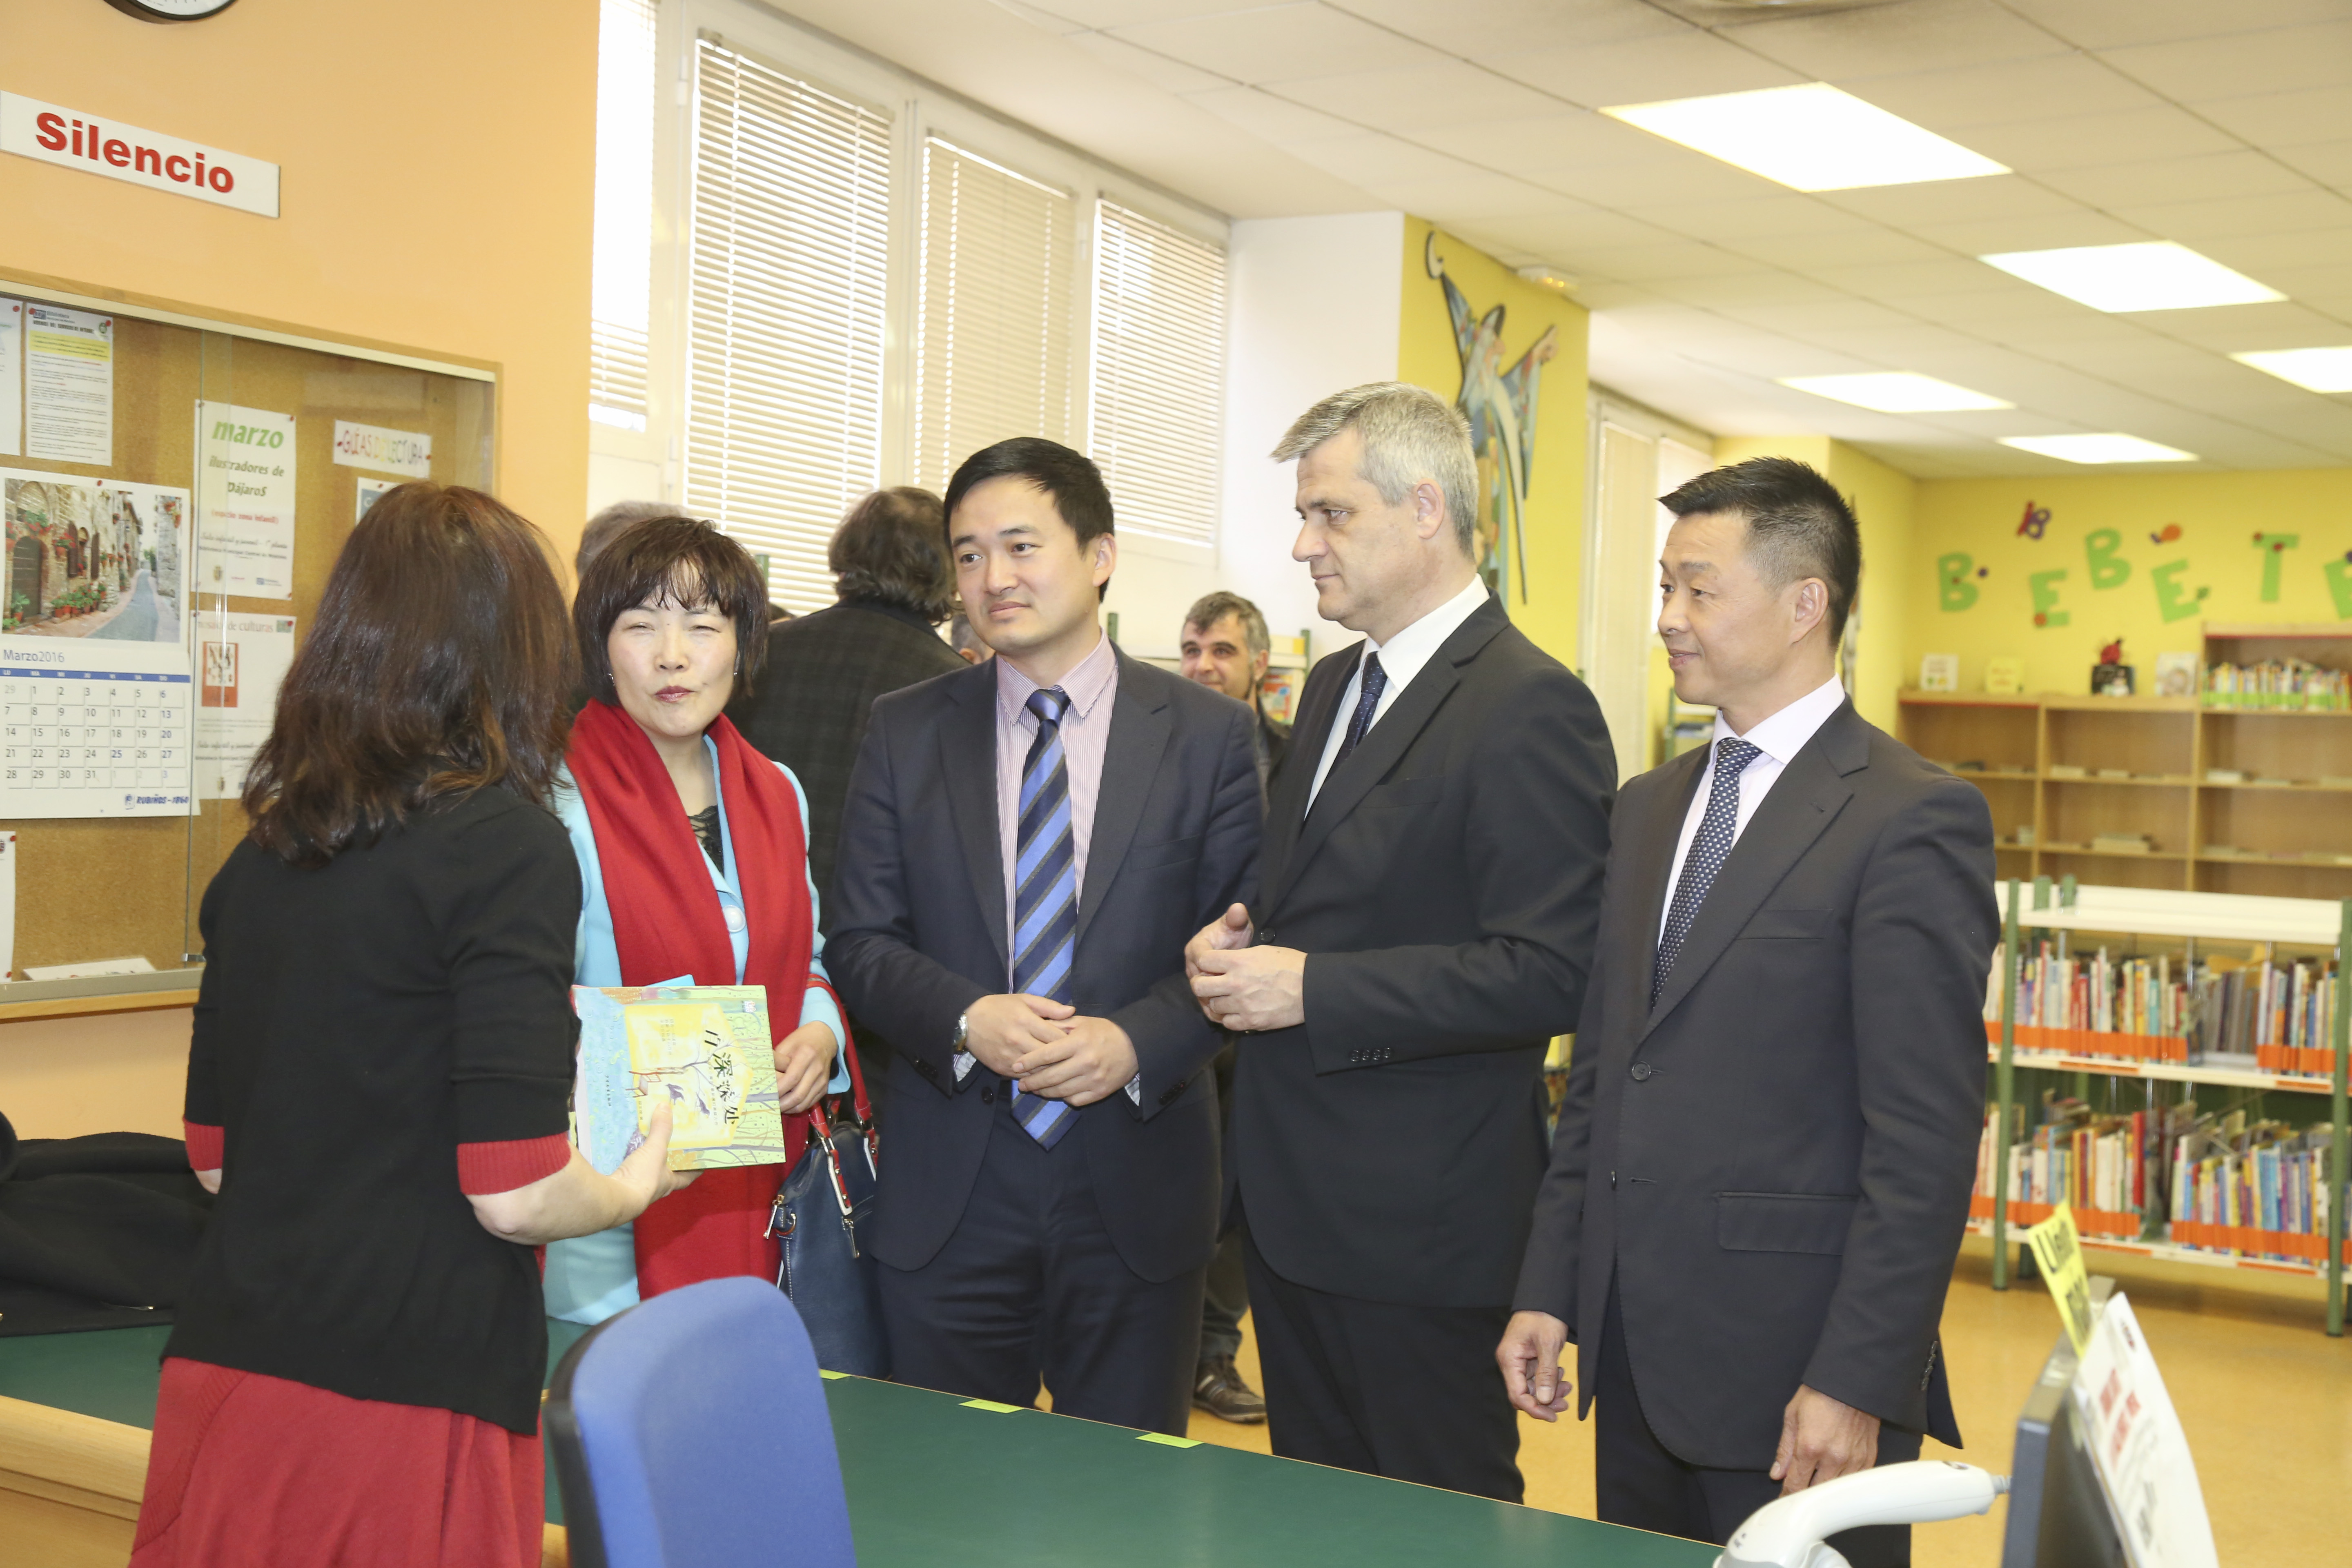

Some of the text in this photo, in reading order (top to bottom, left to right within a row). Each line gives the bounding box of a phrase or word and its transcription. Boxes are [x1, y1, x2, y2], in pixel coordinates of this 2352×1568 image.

[36, 112, 234, 194] Silencio
[212, 421, 285, 448] marzo
[272, 465, 285, 477] de
[239, 620, 274, 633] culturas
[4, 685, 16, 694] 29
[59, 686, 64, 695] 2
[85, 688, 90, 696] 3
[136, 689, 141, 697] 5
[160, 690, 166, 698] 6
[5, 706, 10, 715] 7
[32, 707, 38, 715] 8
[59, 708, 64, 716] 9
[137, 710, 147, 718] 12
[161, 710, 171, 718] 13
[6, 728, 16, 736] 14
[33, 728, 43, 737] 15
[59, 728, 70, 737] 16
[86, 729, 96, 737] 17
[137, 730, 147, 738] 19
[161, 730, 172, 738] 20
[6, 749, 172, 758] 21 22 23 24 25 26 27
[6, 770, 17, 779] 28
[33, 770, 44, 779] 29
[59, 770, 71, 779] 30
[85, 770, 96, 778] 31
